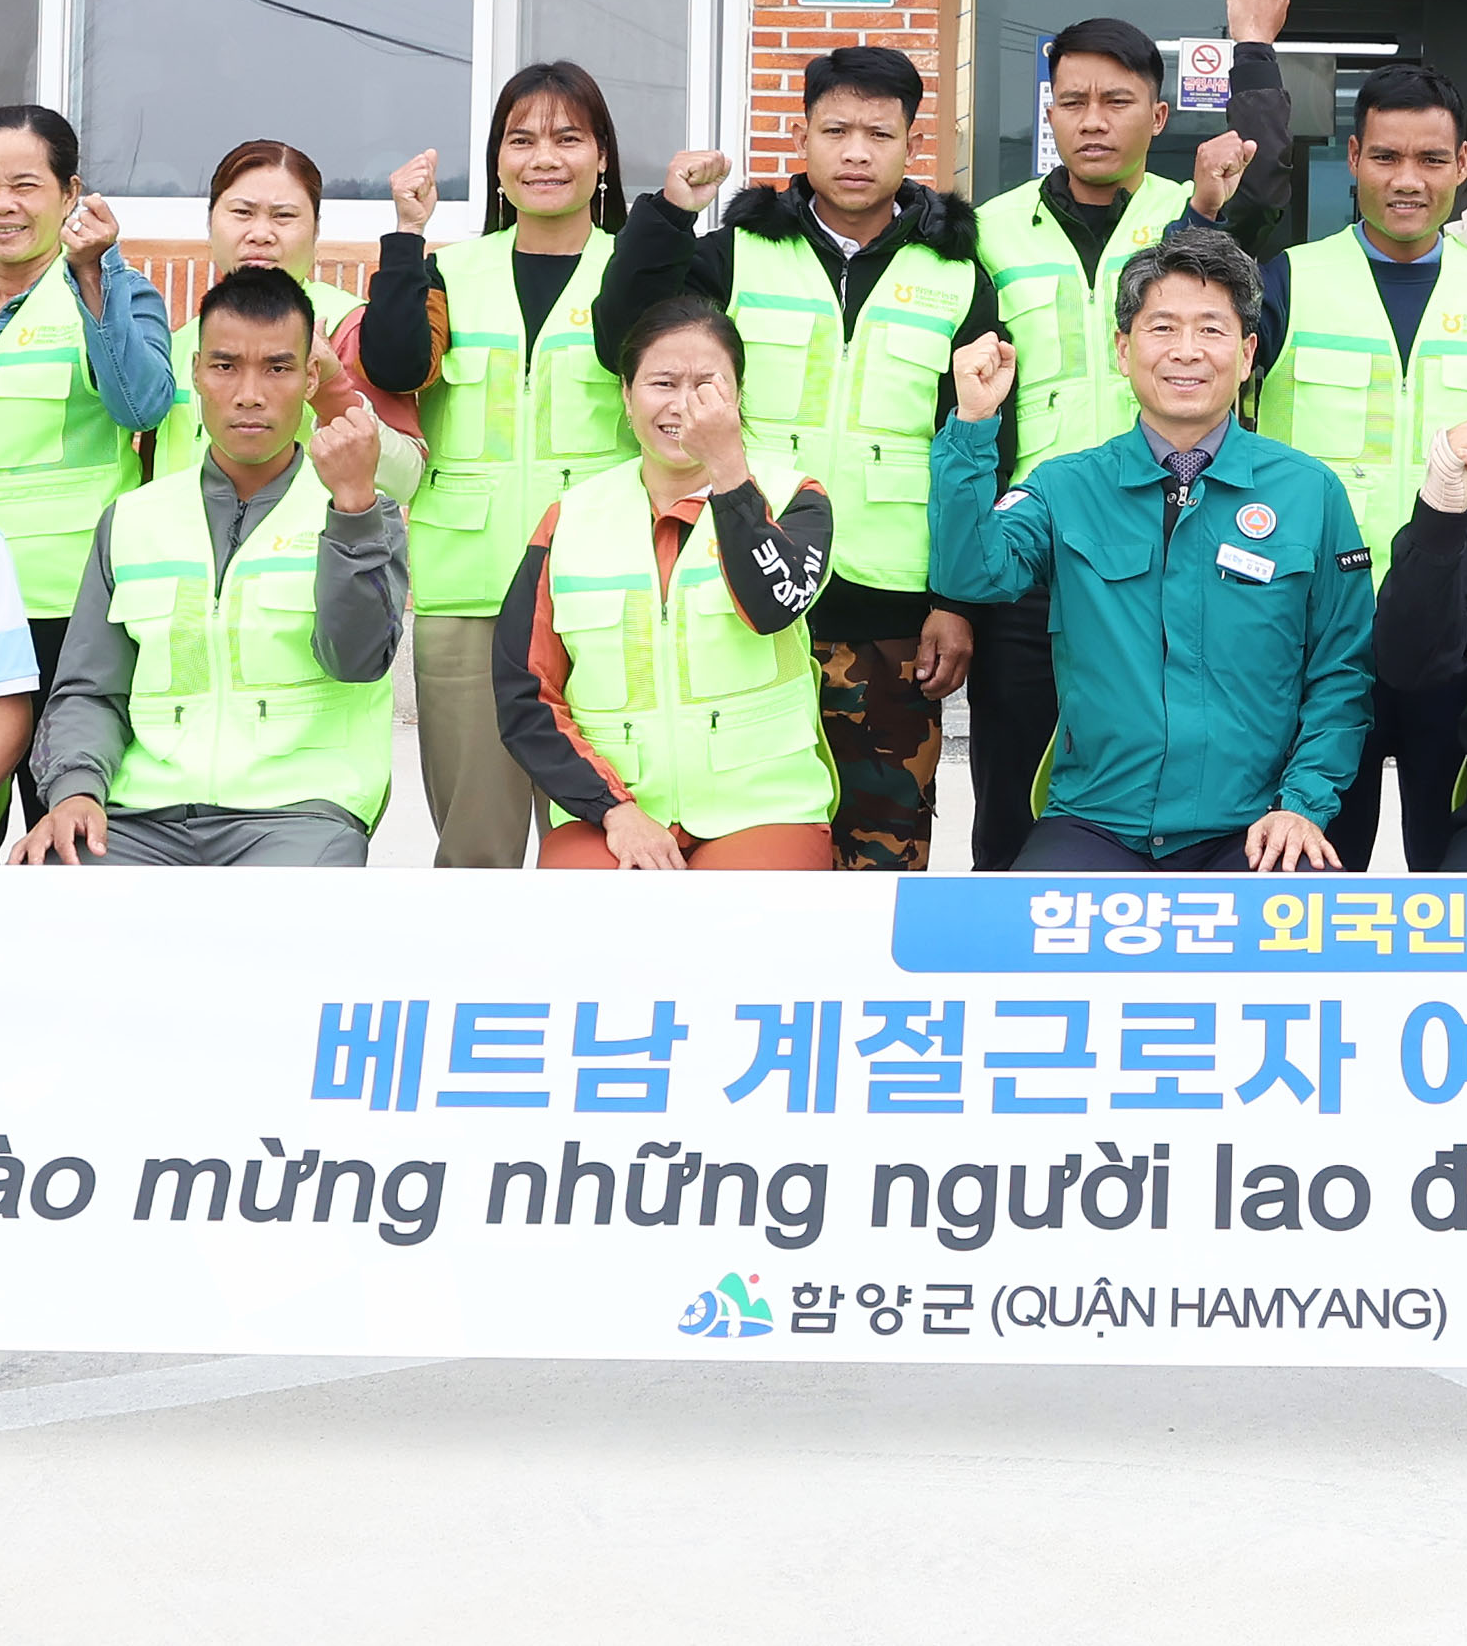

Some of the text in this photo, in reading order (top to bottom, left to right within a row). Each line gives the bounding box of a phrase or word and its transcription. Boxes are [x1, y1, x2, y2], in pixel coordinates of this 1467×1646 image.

[1030, 890, 1239, 955] 함양군
[1260, 893, 1465, 954] 외국인
[313, 1001, 688, 1112] 베트남
[725, 1001, 1355, 1113] 계절근로자
[134, 1138, 446, 1246] mừng
[487, 1141, 828, 1249] những
[872, 1142, 1169, 1251] người
[1216, 1144, 1370, 1231] lao
[790, 1276, 1447, 1342] 함양군 (QUẬN HAMYANG)
